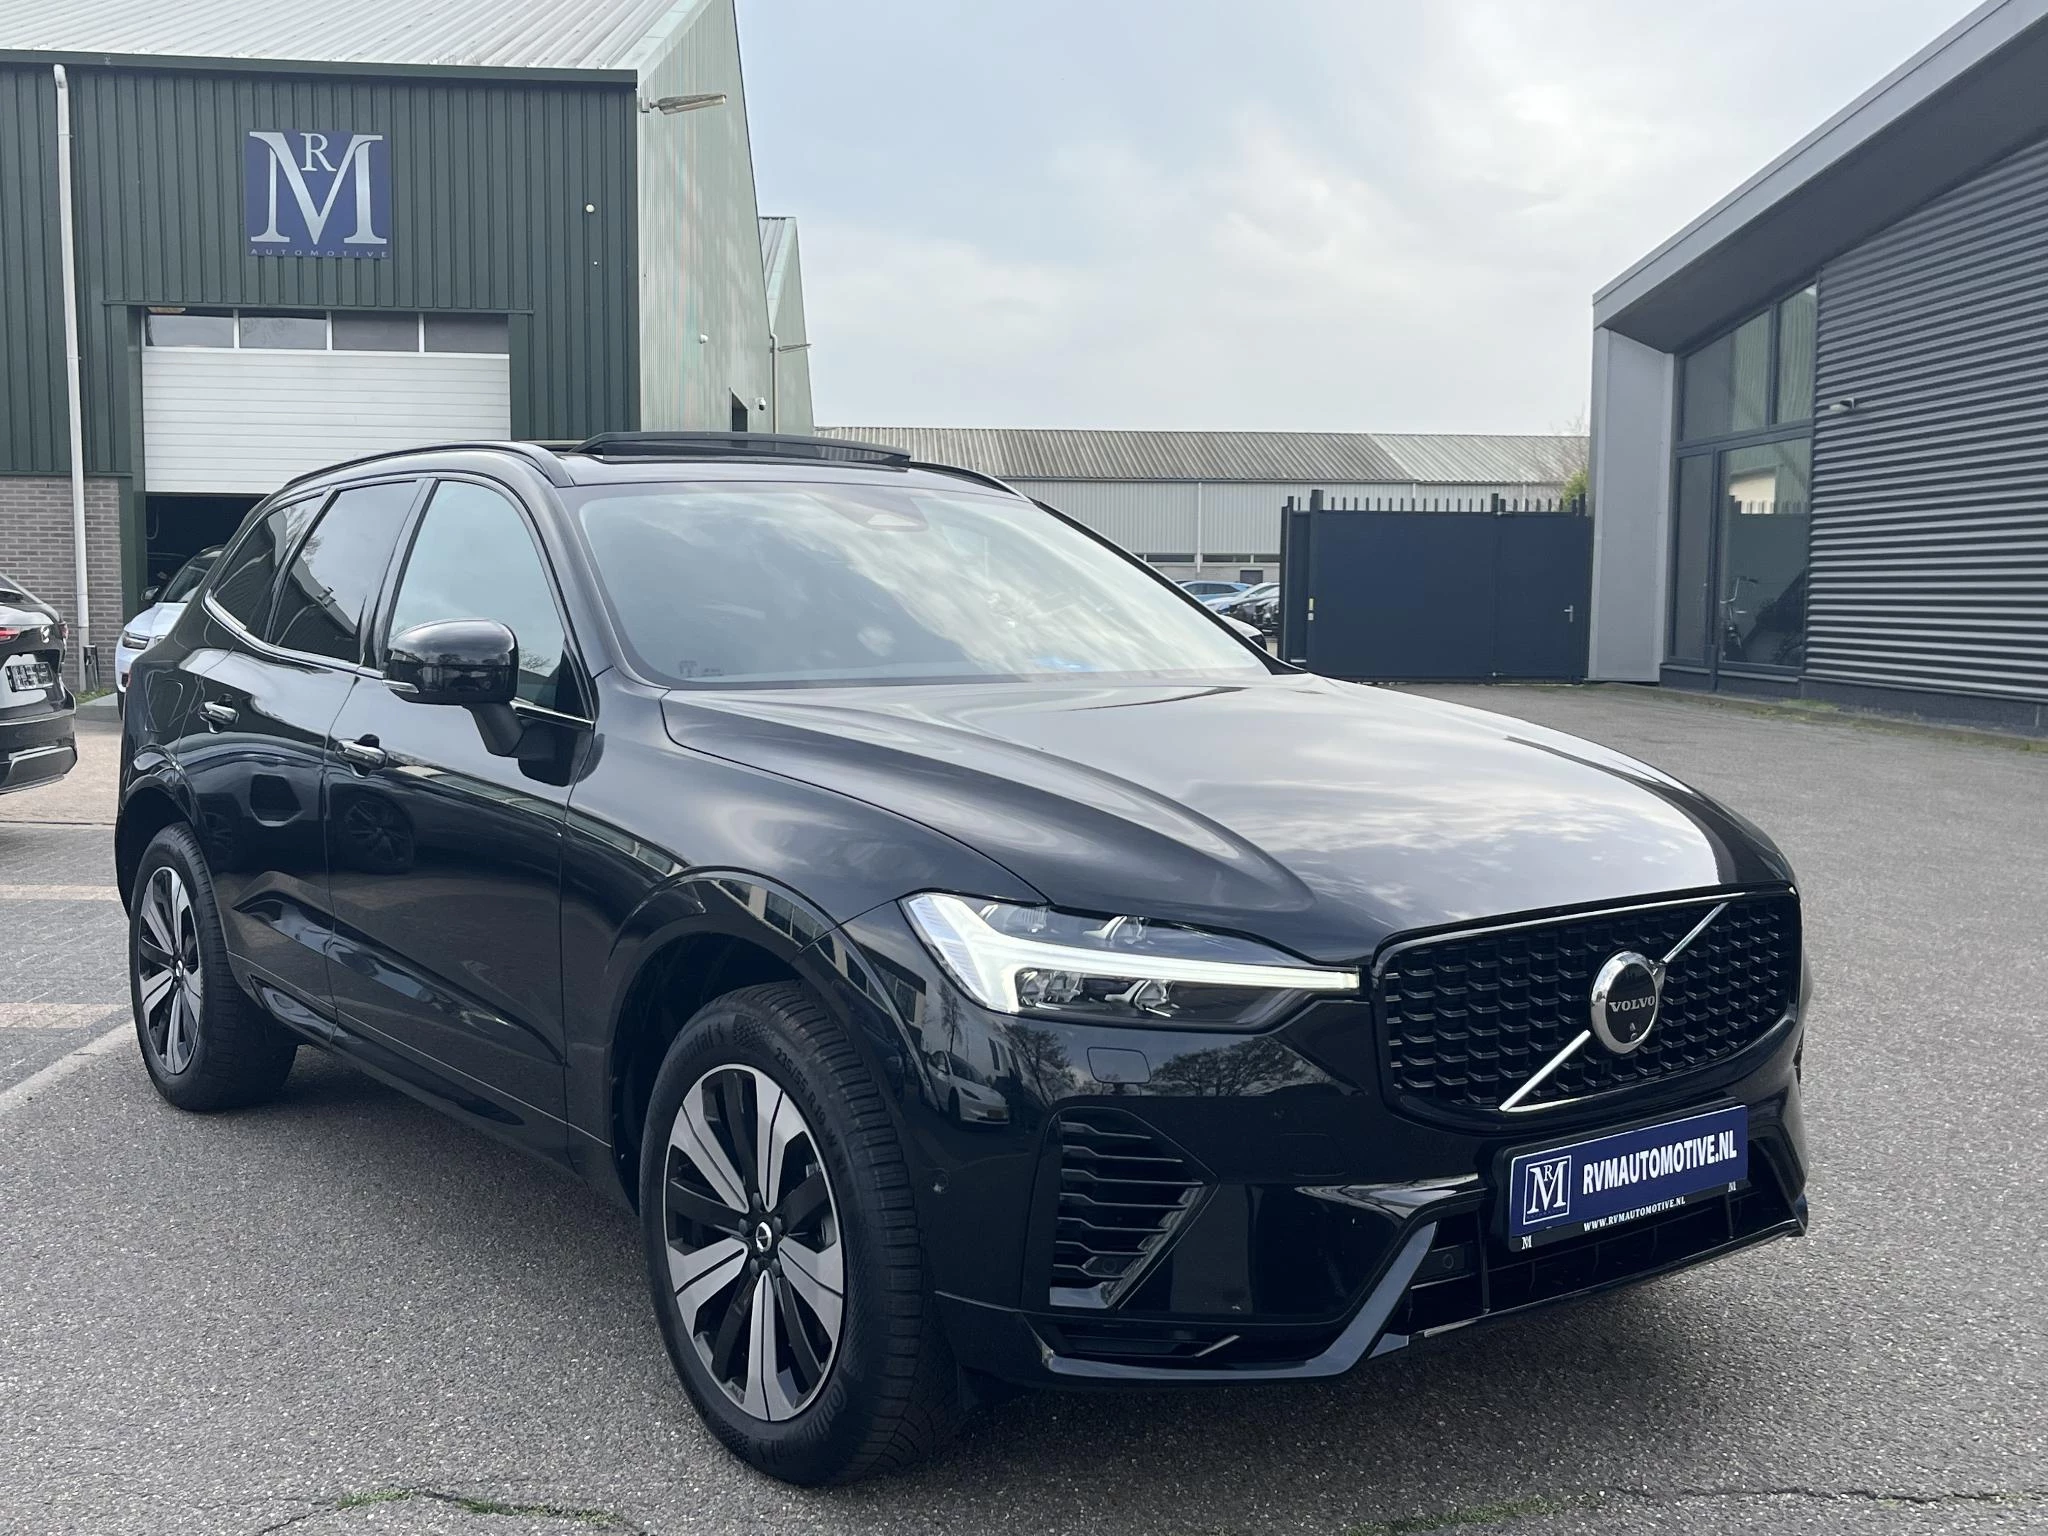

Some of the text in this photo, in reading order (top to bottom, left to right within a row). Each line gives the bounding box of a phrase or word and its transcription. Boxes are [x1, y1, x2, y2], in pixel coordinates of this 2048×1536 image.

[250, 248, 389, 258] AUTOMOTIVE
[1609, 995, 1655, 1012] VOLVO
[1583, 1129, 1738, 1195] RVMAUTOMOTIVE.NL
[1583, 1195, 1686, 1232] WWW.RVMAUTOMOTIVE.NL
